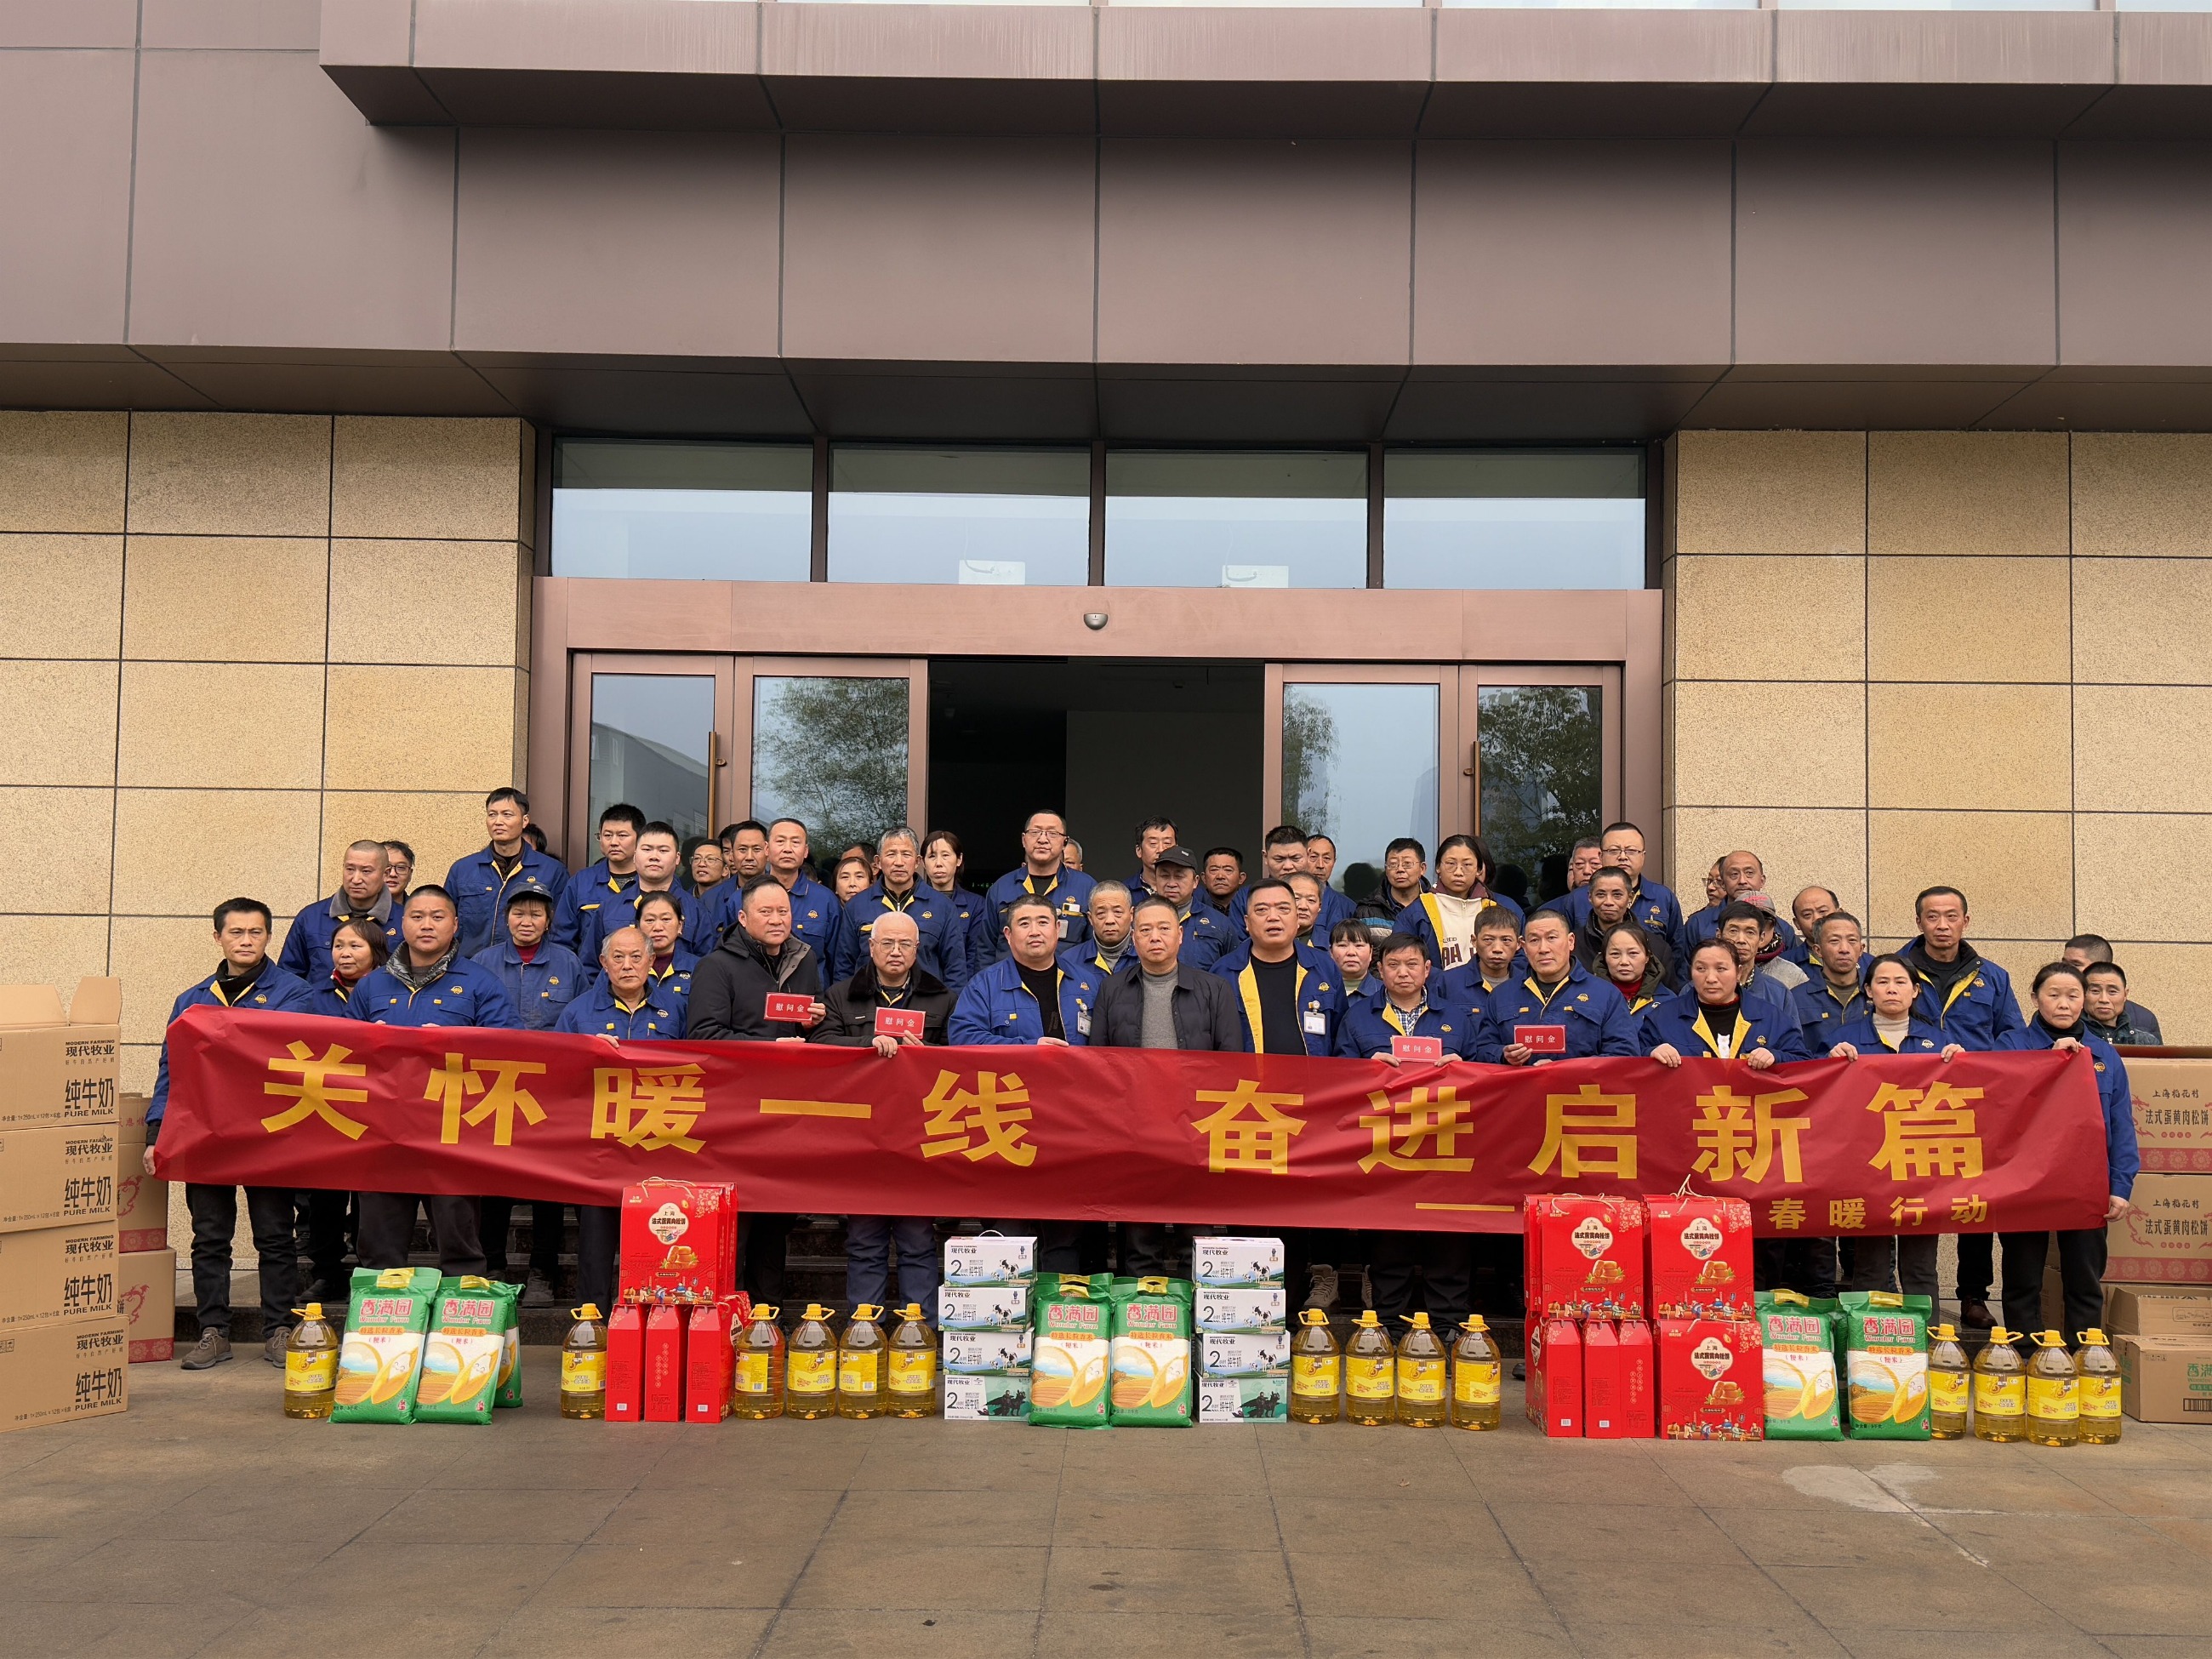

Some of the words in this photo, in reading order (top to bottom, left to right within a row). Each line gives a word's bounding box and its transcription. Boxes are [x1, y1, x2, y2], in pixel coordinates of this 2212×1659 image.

[775, 1003, 804, 1012] 慰问金
[885, 1017, 915, 1027] 慰问金
[1525, 1035, 1555, 1044] 慰问金
[66, 1045, 115, 1057] 现代牧业
[1402, 1045, 1432, 1054] 慰问金
[65, 1078, 114, 1109] 纯牛奶
[2152, 1089, 2199, 1099] 上海稻花村
[262, 1040, 1037, 1166] 关怀暖一线
[1193, 1081, 1986, 1183] 奋进启新篇
[2146, 1109, 2209, 1126] 法式蛋黄肉松饼
[66, 1143, 113, 1155] 现代牧业
[64, 1176, 111, 1208] 纯牛奶
[1768, 1194, 1988, 1229] 春暖行动
[2152, 1198, 2199, 1209] 上海稻花村
[64, 1208, 87, 1217] PURE
[2145, 1219, 2208, 1236] 法式蛋黄肉松饼
[66, 1240, 113, 1254] 现代牧业
[64, 1274, 112, 1307] 纯牛奶
[64, 1307, 87, 1316] PURE
[90, 1303, 111, 1313] MILK
[361, 1299, 413, 1316] 香满园
[442, 1298, 495, 1318] 香满园
[1048, 1304, 1099, 1322] 香满园
[1127, 1303, 1177, 1322] 香满园
[1768, 1314, 1821, 1335] 香满园
[1863, 1316, 1915, 1336] 香满园
[77, 1335, 123, 1350] 现代牧业
[76, 1368, 123, 1403] 纯牛奶
[75, 1402, 98, 1411] PURE
[100, 1398, 122, 1407] MILK
